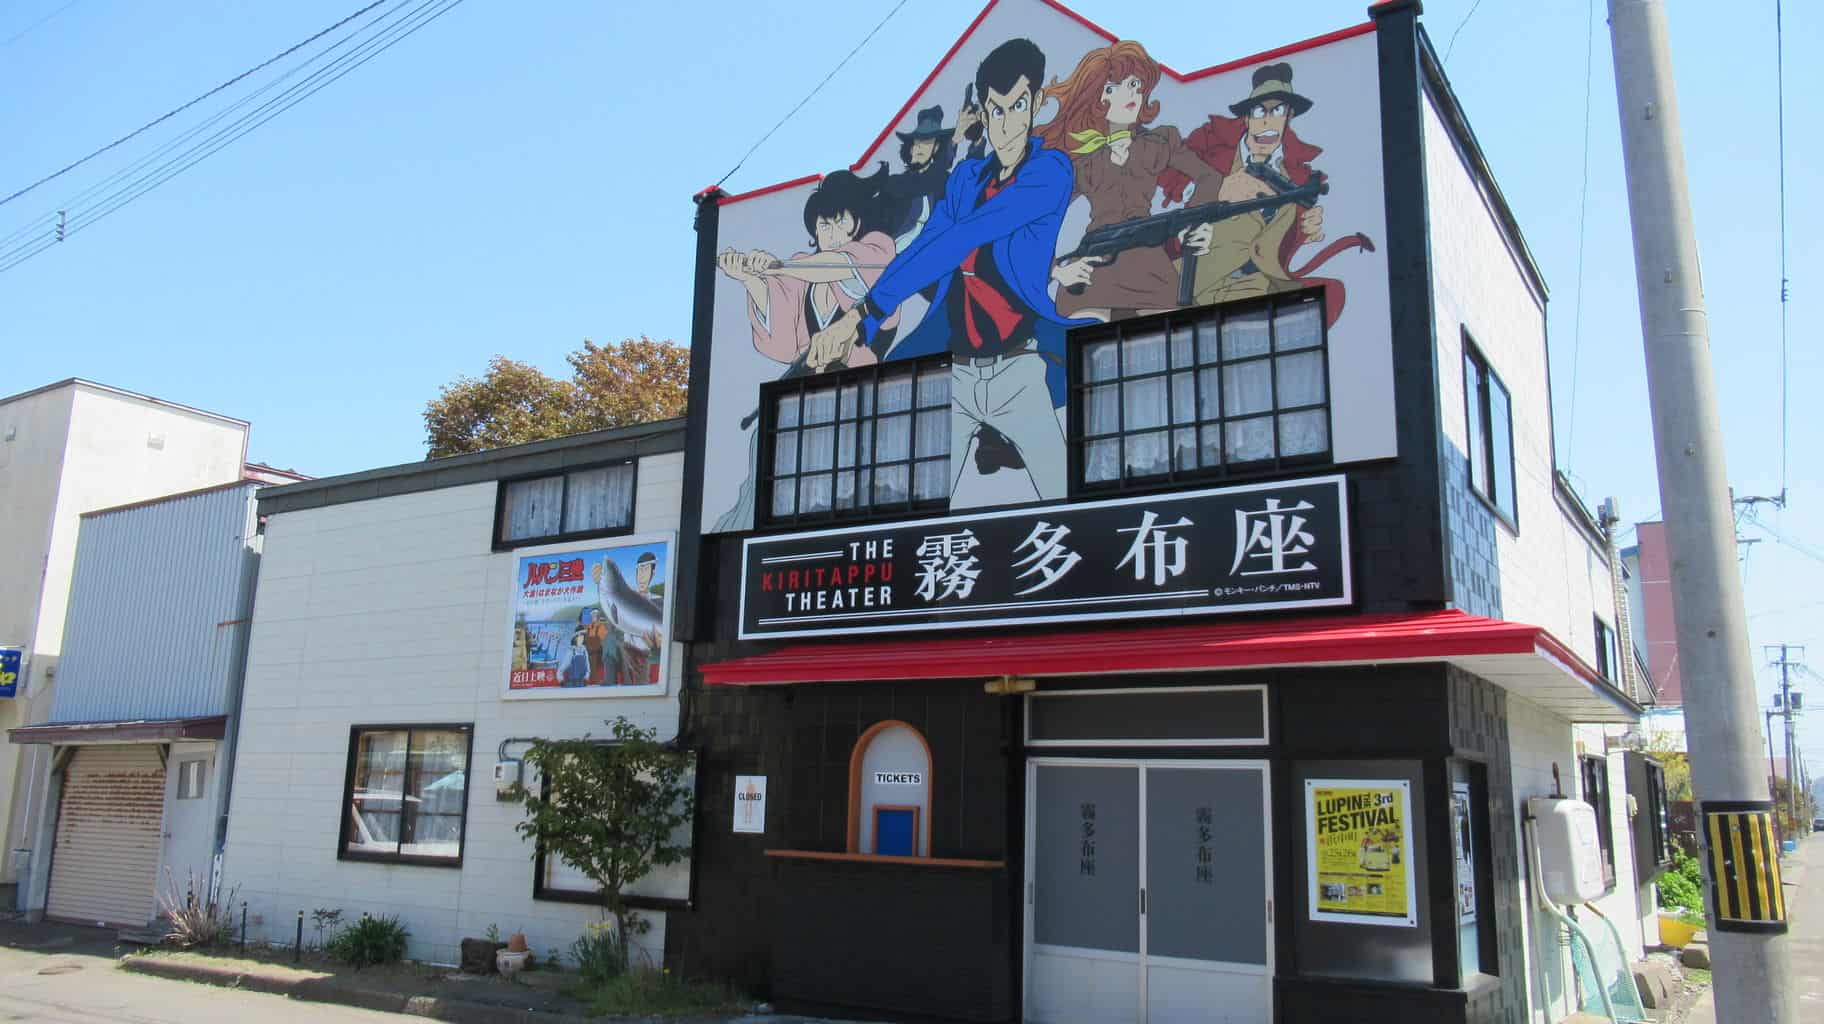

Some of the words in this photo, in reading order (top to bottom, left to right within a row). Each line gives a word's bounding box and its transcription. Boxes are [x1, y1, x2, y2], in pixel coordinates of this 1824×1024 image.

[850, 539, 893, 561] THE
[914, 498, 1318, 601] 霧多布座
[761, 563, 893, 592] KIRITAPPU
[785, 586, 892, 612] THEATER
[877, 773, 921, 783] TICKETS
[1317, 794, 1362, 816] LUPIN
[1374, 792, 1393, 807] 3rd
[1318, 807, 1395, 835] FESTIVAL
